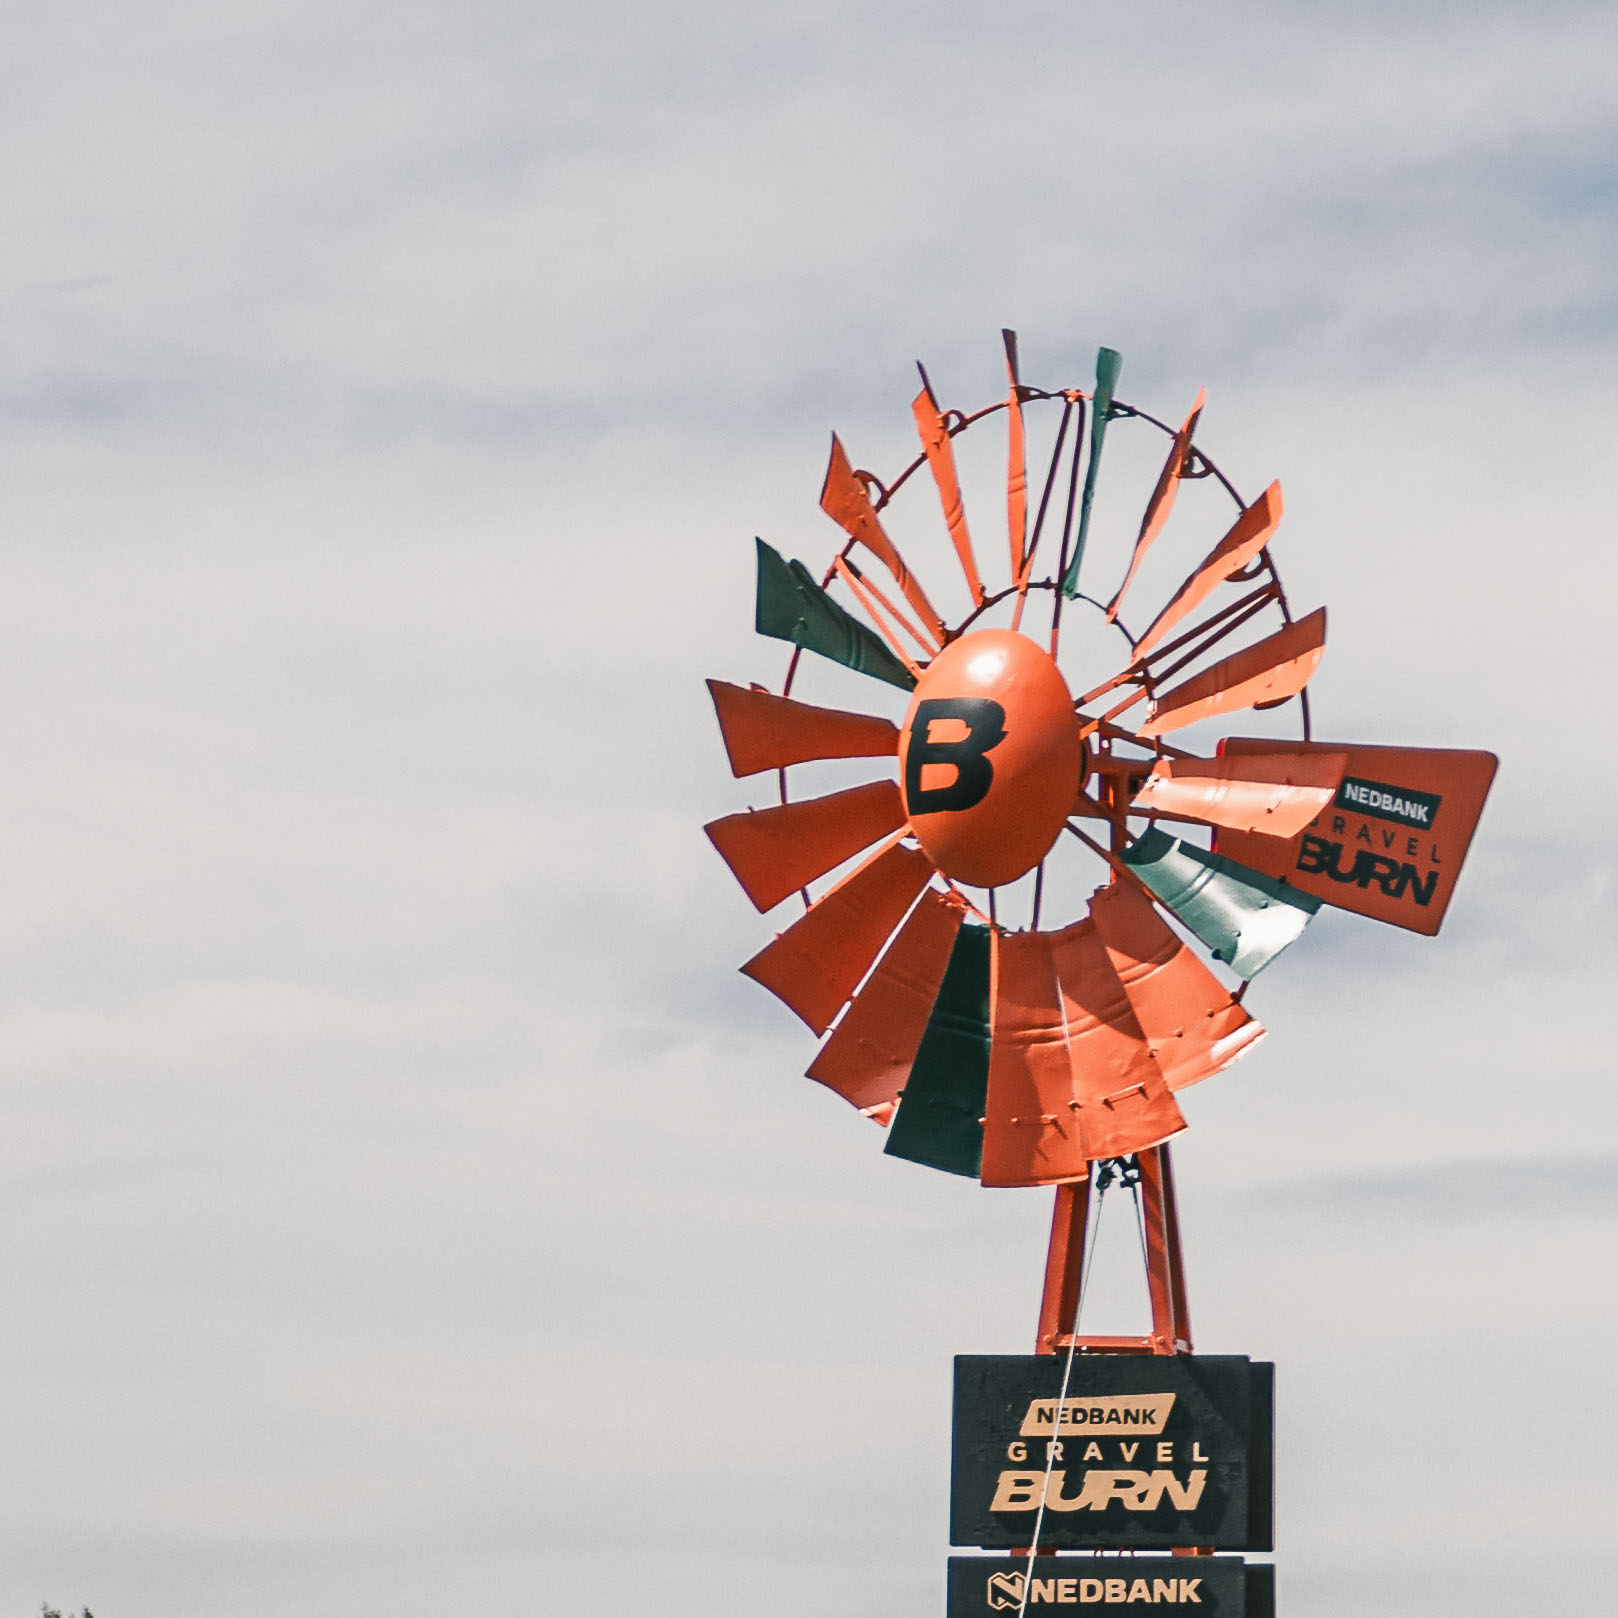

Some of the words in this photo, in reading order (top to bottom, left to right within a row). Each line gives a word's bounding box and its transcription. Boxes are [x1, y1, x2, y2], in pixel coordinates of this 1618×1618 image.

[906, 697, 1009, 816] B
[1345, 783, 1428, 822] NEDBANK
[1296, 833, 1439, 906] BURN
[1037, 1406, 1156, 1425] NEDBANK
[1007, 1441, 1209, 1462] GRAVEL
[989, 1469, 1208, 1512] BURN
[1030, 1578, 1203, 1603] NEDBANK
